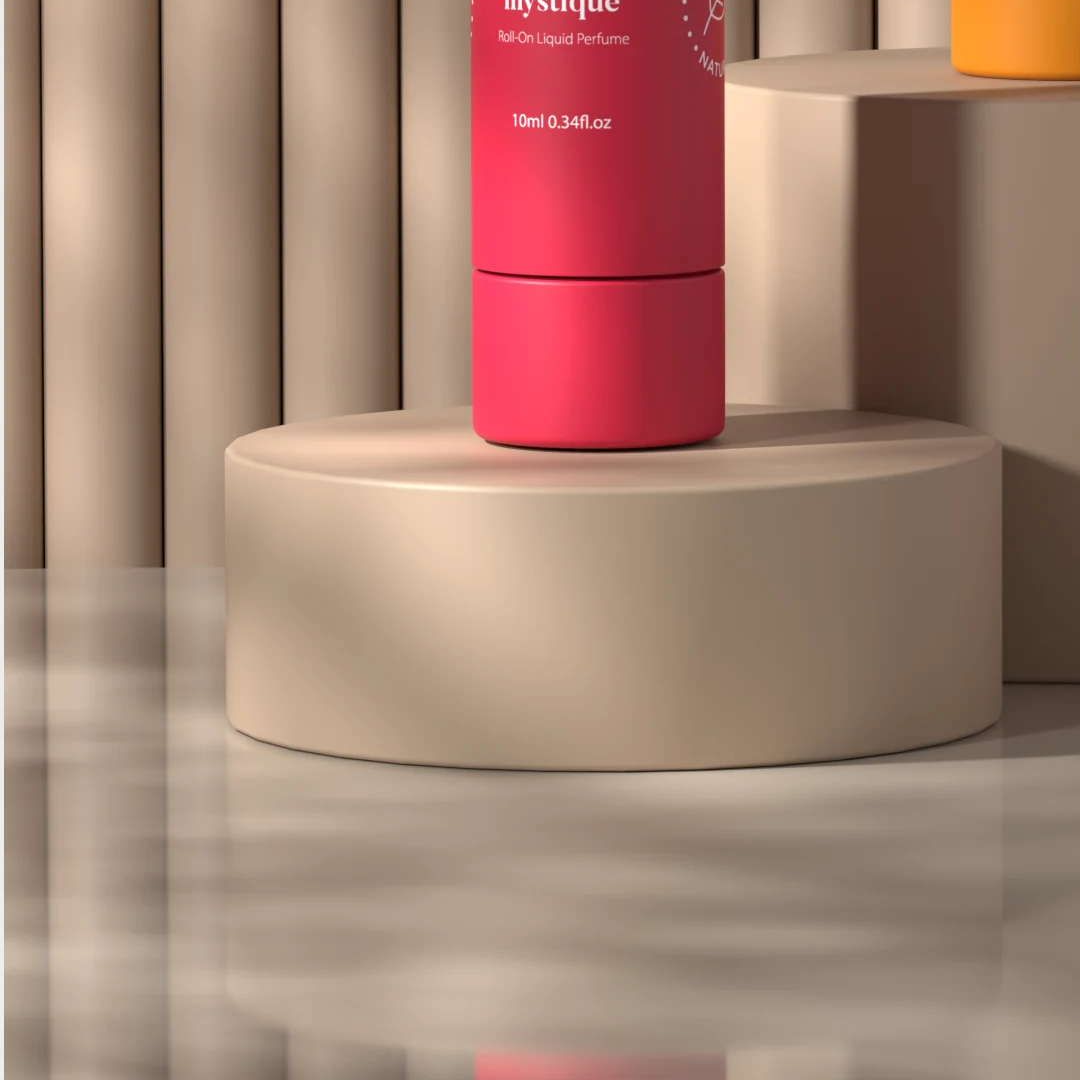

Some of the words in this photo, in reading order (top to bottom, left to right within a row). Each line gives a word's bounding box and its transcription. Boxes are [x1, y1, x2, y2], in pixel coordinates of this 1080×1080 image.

[498, 30, 534, 44] Roll-On
[537, 32, 573, 47] Liquid
[577, 32, 630, 45] Perfume
[512, 114, 544, 128] 10ml
[548, 115, 612, 130] 0.34fl.oz
